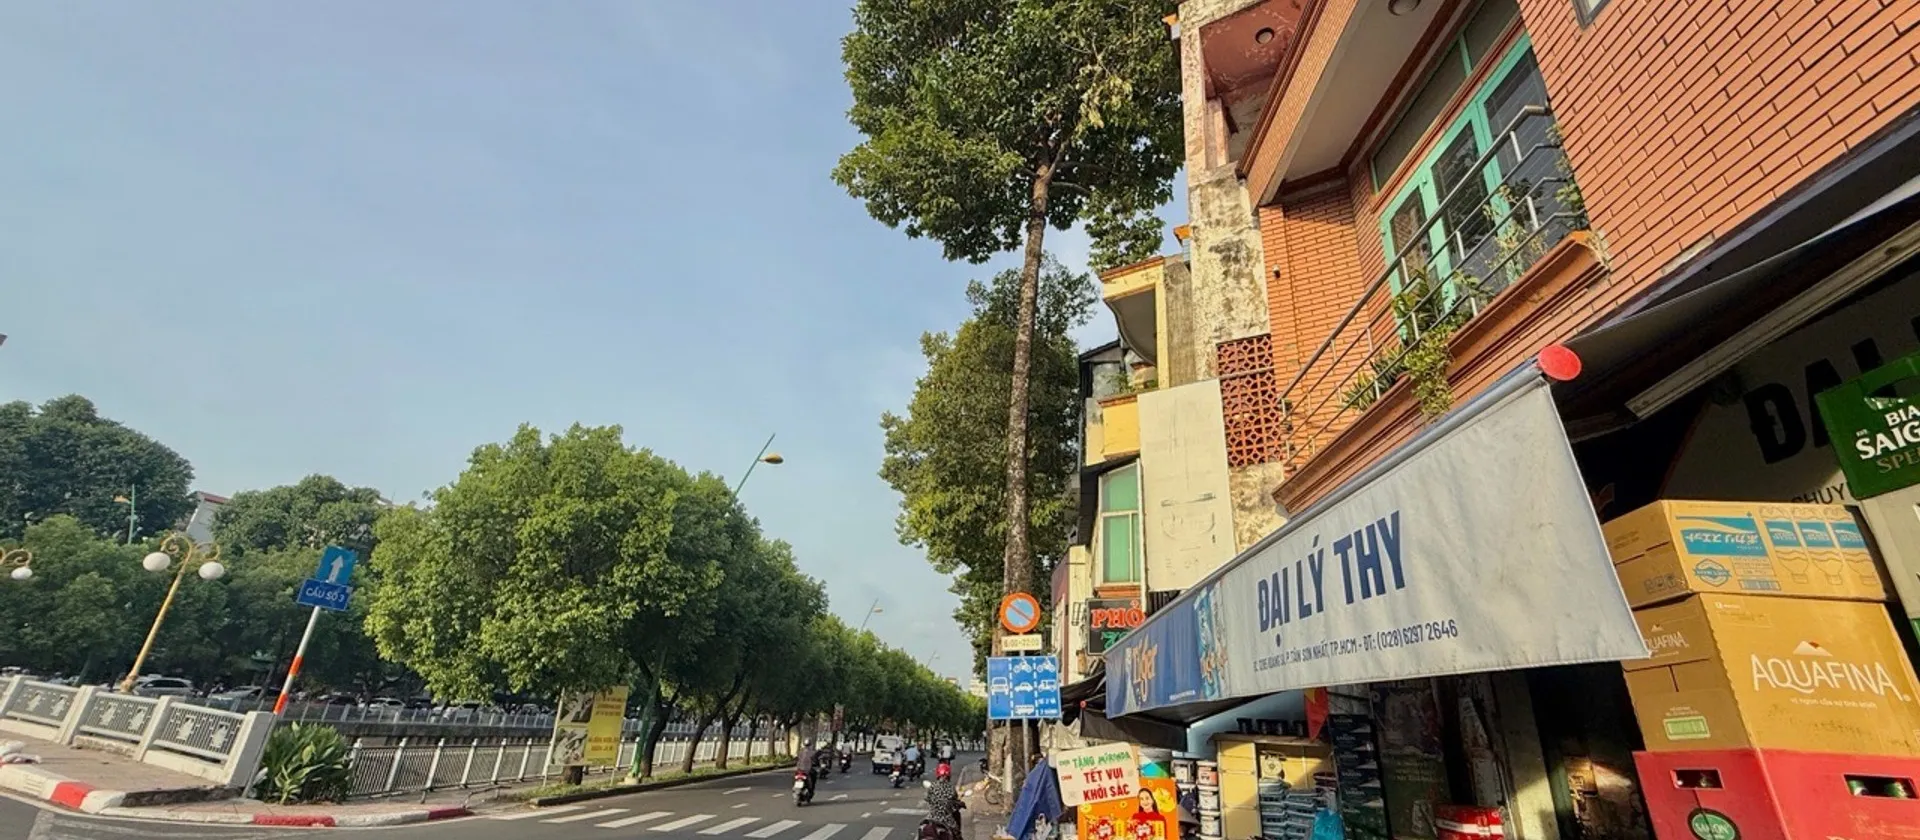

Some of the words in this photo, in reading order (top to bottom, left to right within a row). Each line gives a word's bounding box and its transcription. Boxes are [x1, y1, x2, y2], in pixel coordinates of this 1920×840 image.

[1884, 405, 1920, 427] BIA
[1258, 566, 1290, 647] ĐẠI
[1296, 534, 1324, 620] LÝ
[1333, 510, 1405, 605] THY
[338, 594, 345, 603] 3
[1091, 600, 1146, 628] PHỞ
[1425, 619, 1458, 640] 2646
[1751, 654, 1904, 701] AQUAFINA
[1083, 766, 1102, 784] TẾT
[1105, 767, 1123, 780] VUI
[1083, 783, 1108, 801] KHỞI
